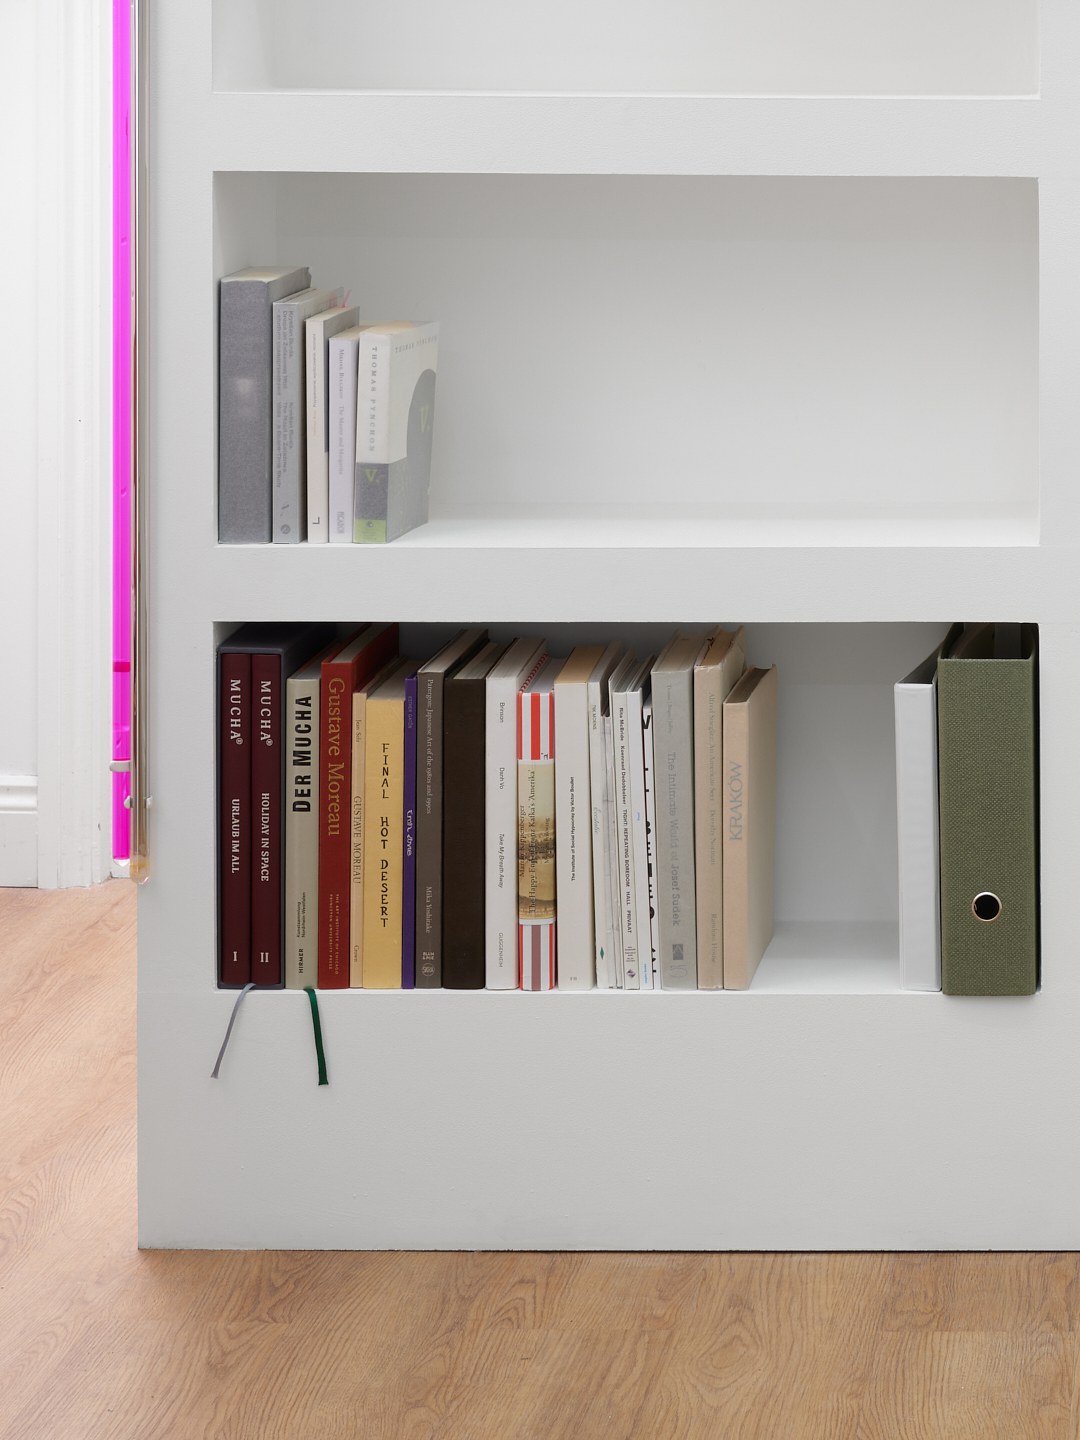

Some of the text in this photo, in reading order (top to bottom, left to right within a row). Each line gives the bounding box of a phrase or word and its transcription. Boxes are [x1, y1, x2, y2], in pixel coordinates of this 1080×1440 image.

[370, 346, 378, 392] THOMAS
[426, 679, 434, 708] Parergon:
[426, 709, 434, 736] Japanese
[292, 696, 311, 813] DER MUCHA
[328, 677, 345, 836] Gustave Moreau
[426, 738, 434, 747] Art
[426, 756, 434, 765] the
[667, 751, 677, 771] The
[426, 785, 434, 796] and
[499, 782, 506, 790] Vo
[668, 773, 678, 816] Intimate
[729, 760, 742, 842] KRAKÓW
[528, 803, 537, 828] Kafka's
[231, 798, 240, 874] URLAUB IM ALL
[261, 792, 271, 882] HOLIDAY IN SPACE
[354, 796, 362, 884] GUSTAVE MOREAU
[379, 743, 390, 927] FINAL HOT DESERT
[498, 846, 505, 855] My
[528, 873, 537, 897] Happy
[670, 863, 680, 891] Josef
[528, 898, 537, 914] The
[672, 893, 680, 926] Sudek
